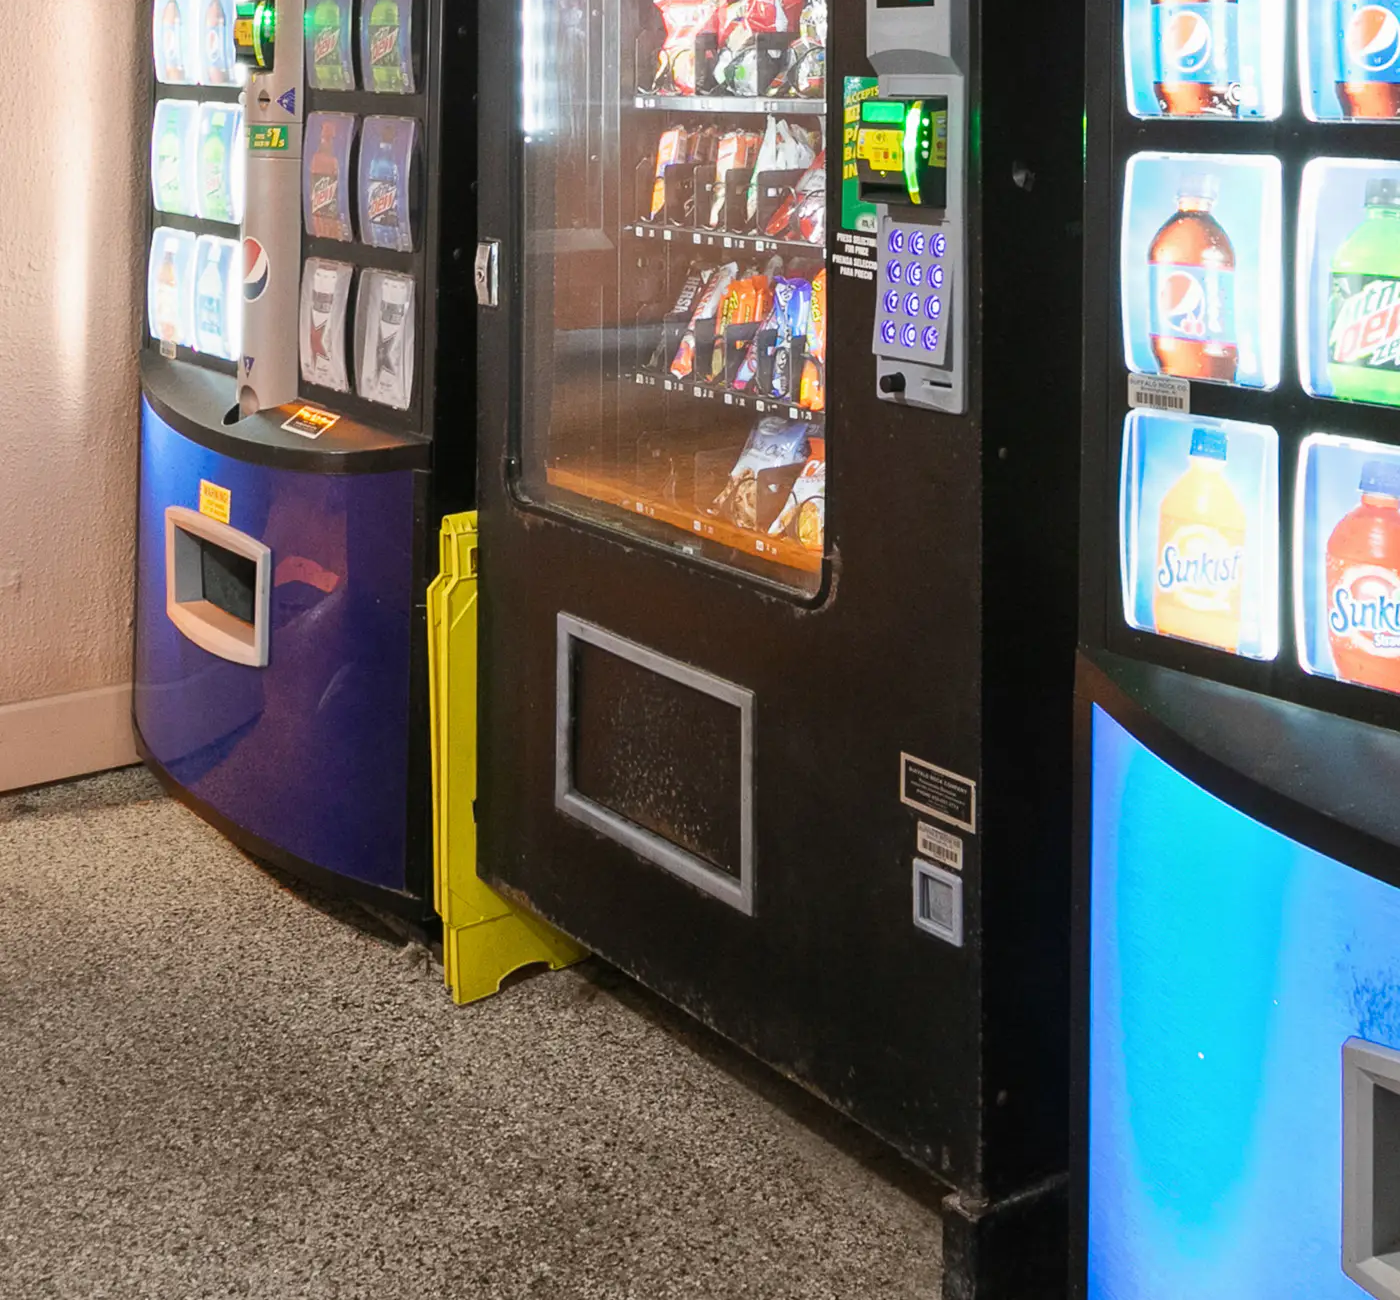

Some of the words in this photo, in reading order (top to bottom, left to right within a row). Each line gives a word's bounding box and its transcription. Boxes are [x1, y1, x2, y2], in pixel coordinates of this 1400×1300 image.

[853, 235, 877, 247] SELECTIO
[853, 257, 877, 270] SELECCIO
[1158, 380, 1175, 390] ROCK
[1157, 544, 1244, 590] Sunkist
